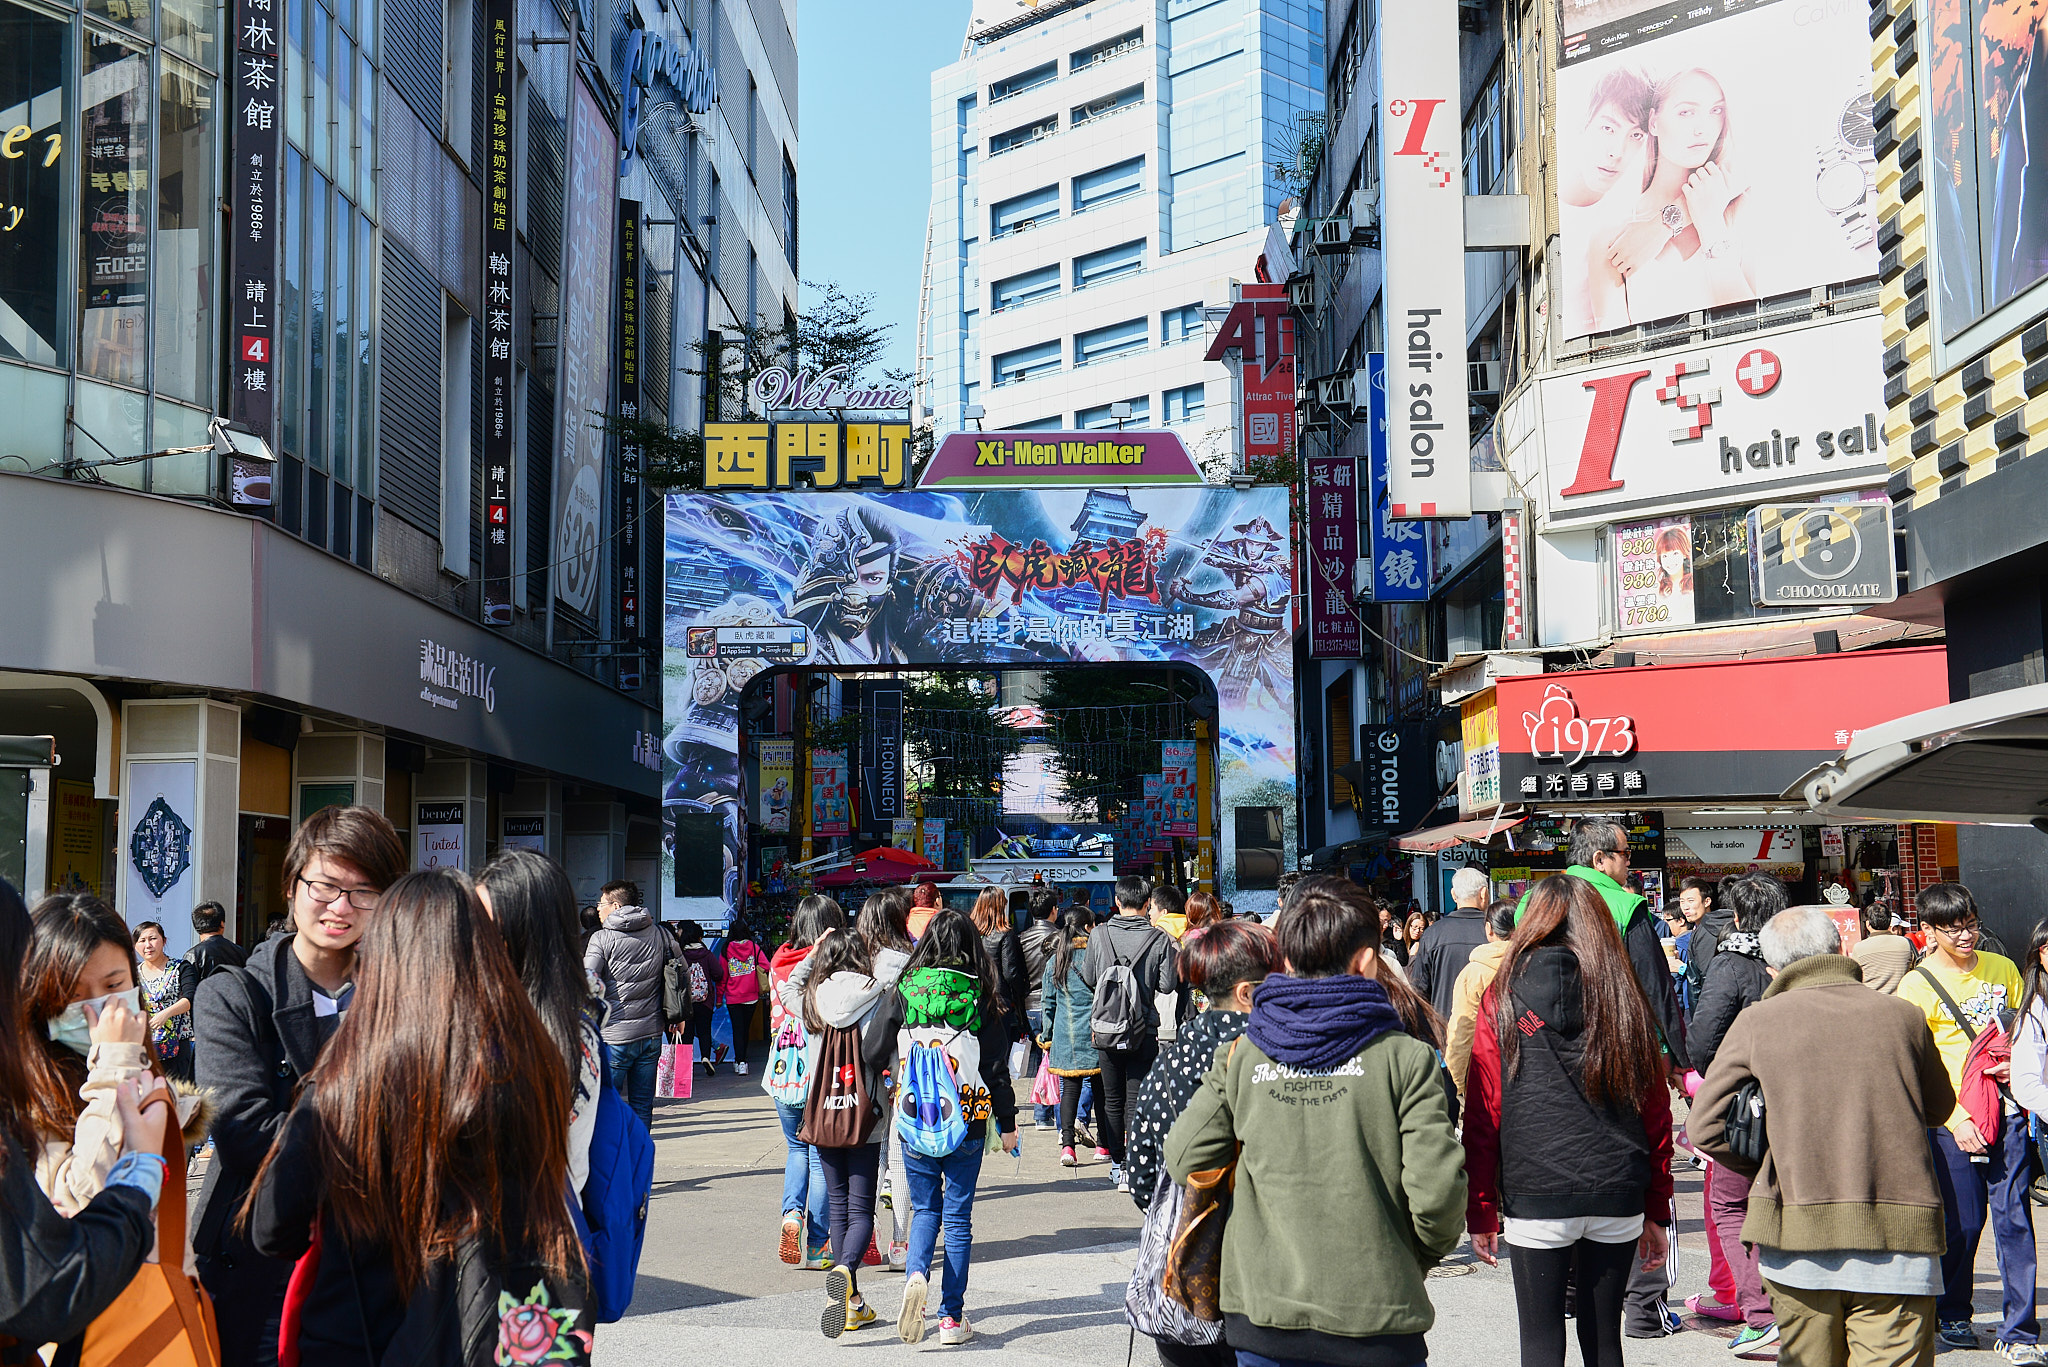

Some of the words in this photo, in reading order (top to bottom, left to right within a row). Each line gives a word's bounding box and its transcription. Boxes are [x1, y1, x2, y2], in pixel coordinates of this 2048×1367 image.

[1600, 35, 1616, 46] Calvin
[1616, 31, 1630, 41] Klein
[249, 153, 264, 242] 創立於1986年
[488, 252, 511, 360] 翰林茶館
[243, 279, 268, 391] 請上4樓
[1407, 308, 1443, 374] hair
[1246, 391, 1273, 401] Attrac
[1275, 391, 1294, 401] Tive
[1408, 382, 1444, 478] salon
[974, 440, 1058, 465] Xi-Men
[1061, 441, 1145, 465] Walker
[1718, 428, 1800, 473] hair
[1815, 412, 1890, 458] sal
[703, 421, 913, 489] 西門町
[490, 465, 507, 545] 請上4樓
[1321, 492, 1346, 616] 精品沙龍
[1622, 538, 1656, 557] 980
[1623, 571, 1657, 590] 980
[623, 565, 636, 628] 請上4樓
[1627, 605, 1670, 626] 1780
[942, 613, 1194, 644] 這裡才是你的真江湖
[1317, 620, 1356, 635] 化粧品
[881, 736, 895, 814] H:CONNECT
[1520, 771, 1642, 794] 繼光香香雞
[1380, 755, 1400, 825] TOUGH
[420, 804, 463, 822] benefit
[506, 820, 543, 834] benefit
[419, 832, 461, 852] Tinted
[1201, 847, 1209, 858] H
[1710, 840, 1724, 849] hair
[1725, 841, 1745, 849] salon
[1199, 864, 1210, 873] 41
[1252, 1062, 1279, 1084] The
[1268, 1088, 1297, 1106] RAISE
[1301, 1097, 1320, 1107] THE
[1322, 1086, 1348, 1104] FISTS
[1284, 1080, 1333, 1092] FIGHTER
